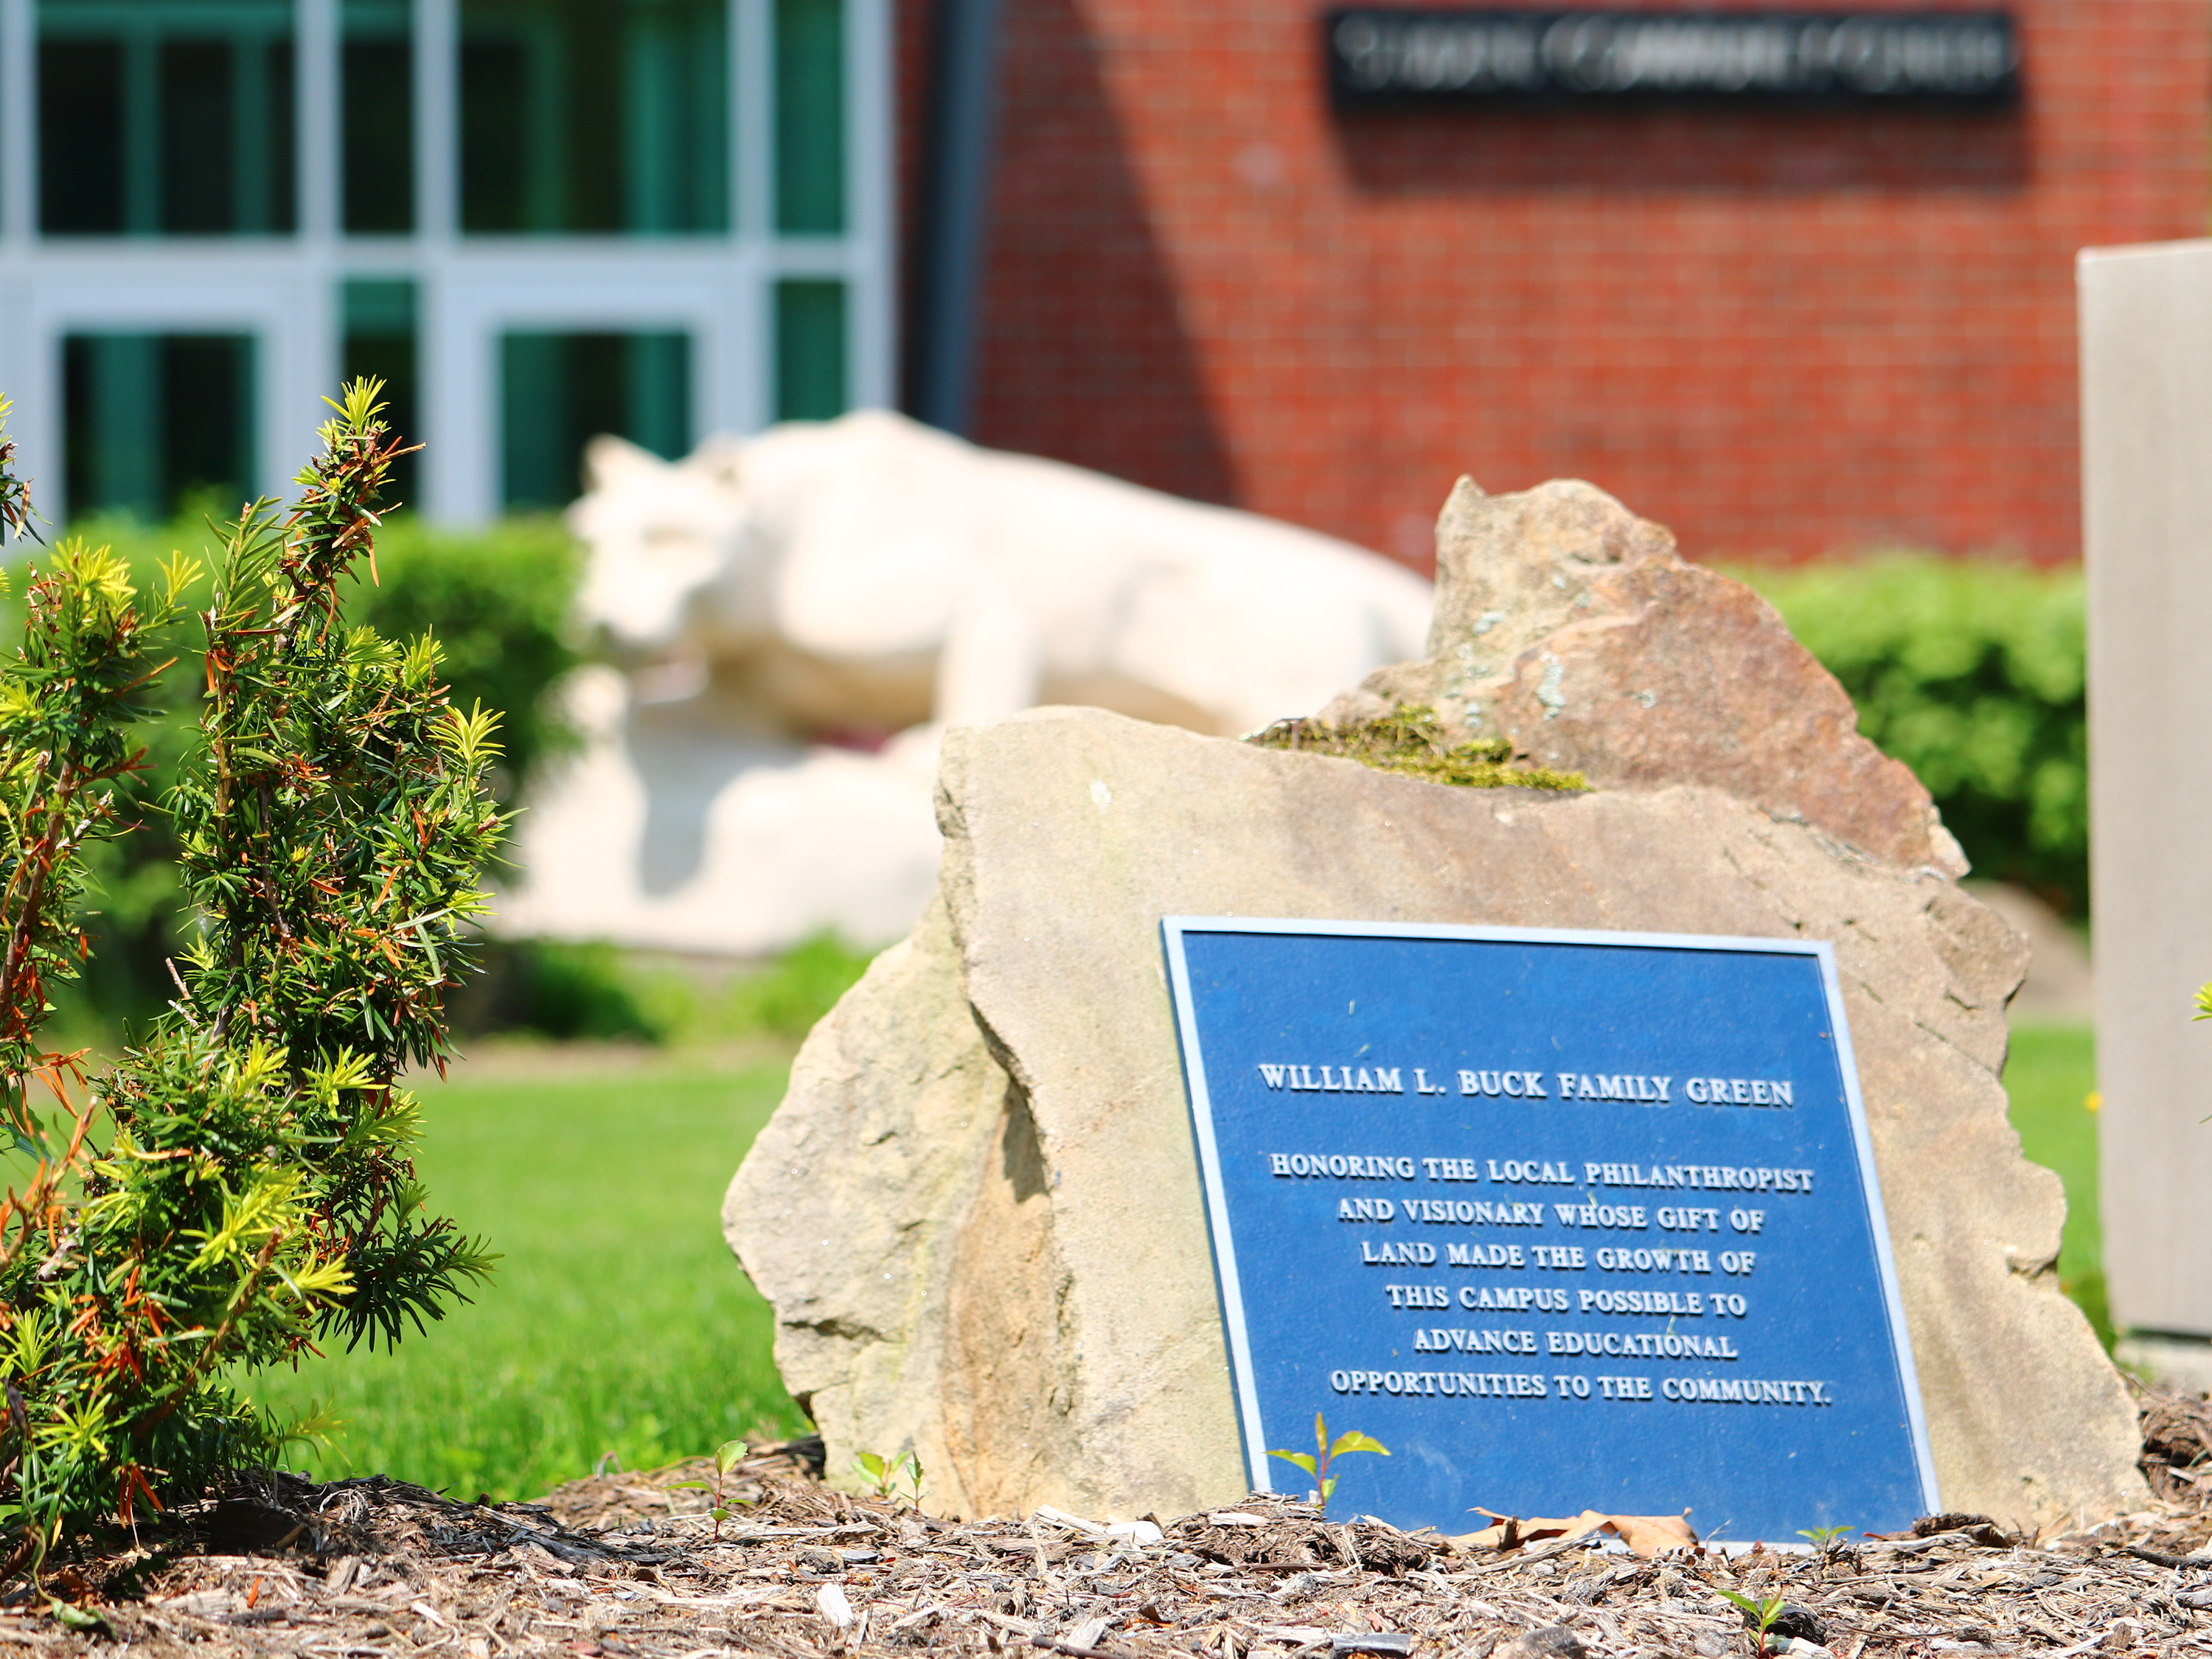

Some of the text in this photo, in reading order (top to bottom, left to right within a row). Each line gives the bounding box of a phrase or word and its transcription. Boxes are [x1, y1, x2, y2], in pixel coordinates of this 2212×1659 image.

[1257, 1062, 1794, 1106] WILLIAM L. BUCK FAMILY GREEN
[1268, 1152, 1815, 1191] HONORING THE LOCAL PHILANTHROPIST
[1338, 1197, 1767, 1233] AND VISIONARY WHOSE GIFT OF
[1359, 1240, 1758, 1276] LAND MADE THE GROWTH OF
[1385, 1283, 1748, 1316] THIS CAMPUS POSSIBLE TO
[1413, 1326, 1739, 1358] ADVANCE EDUCATIONAL
[1328, 1369, 1833, 1404] OPPORTUNITIES TO THE COMMUNITY.
